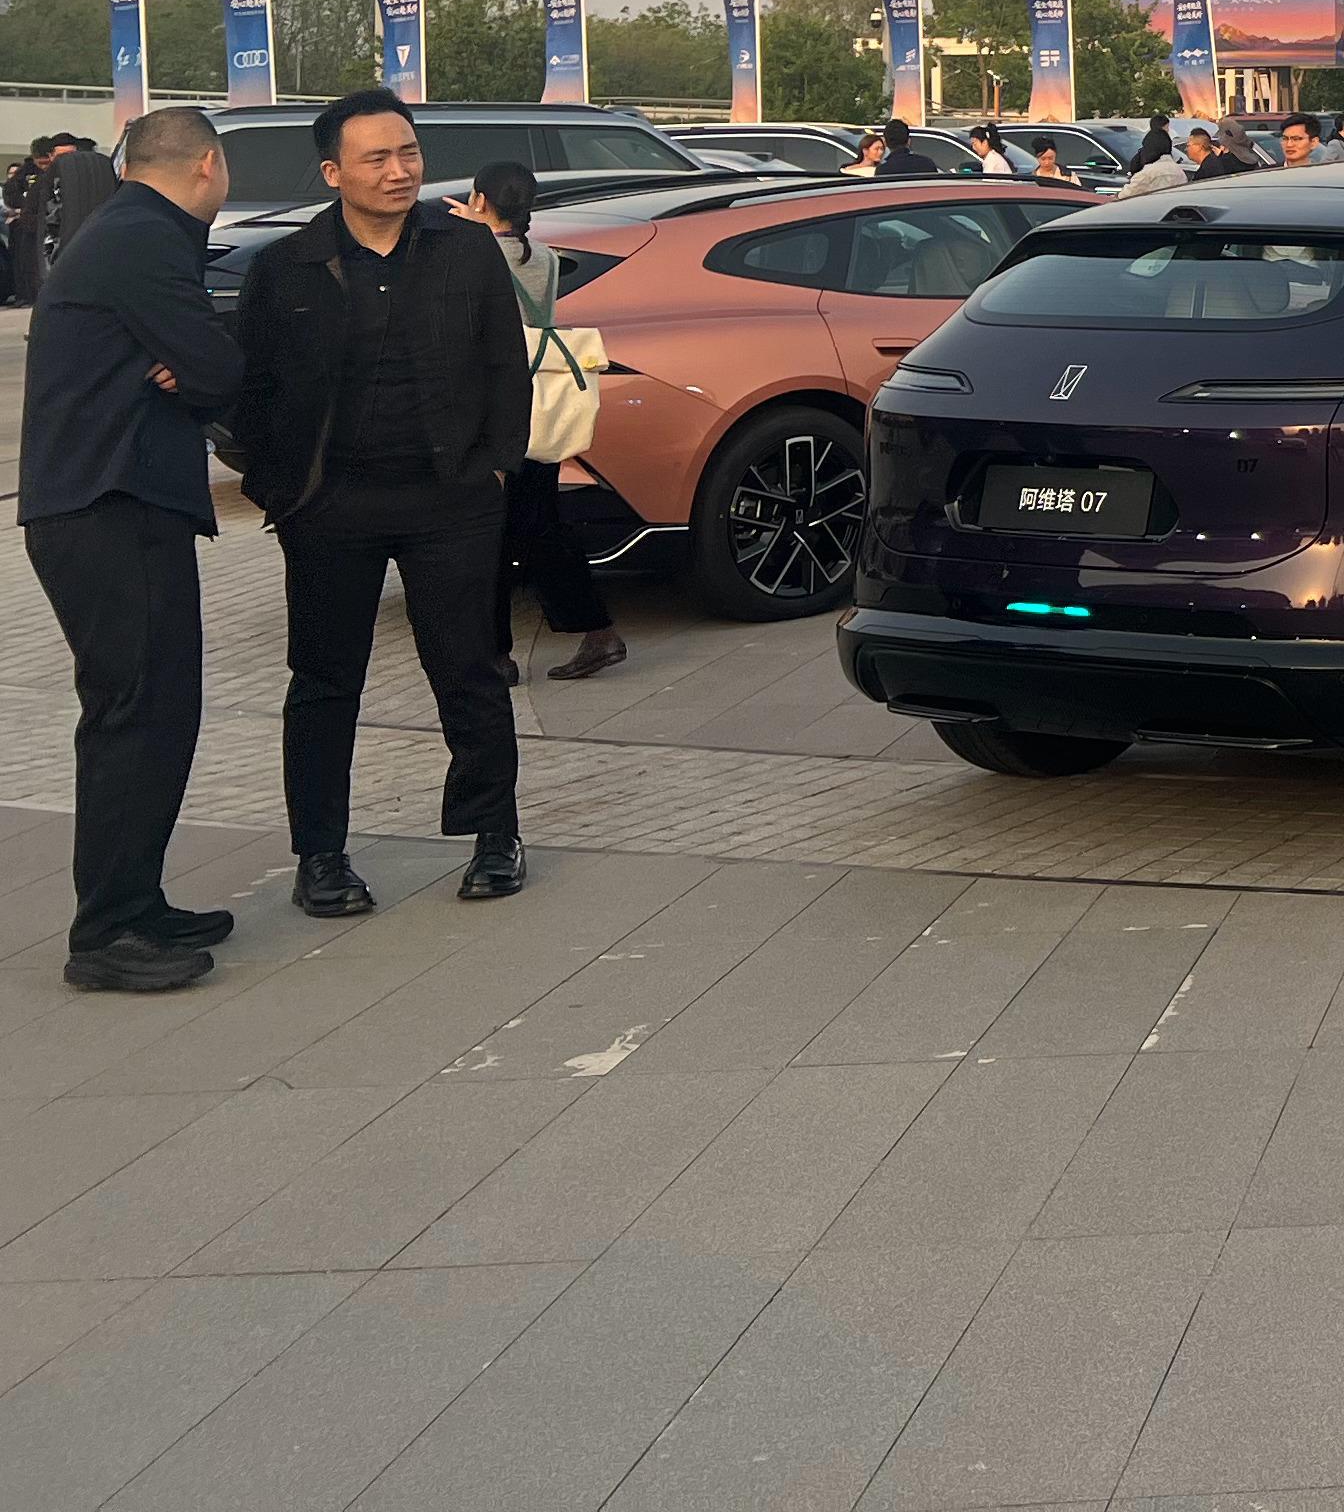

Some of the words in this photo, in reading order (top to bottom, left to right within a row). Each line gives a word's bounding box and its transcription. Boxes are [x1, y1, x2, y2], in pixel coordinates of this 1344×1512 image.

[1237, 458, 1258, 473] 07
[1018, 487, 1076, 513] 阿维塔
[1080, 491, 1108, 513] 07
